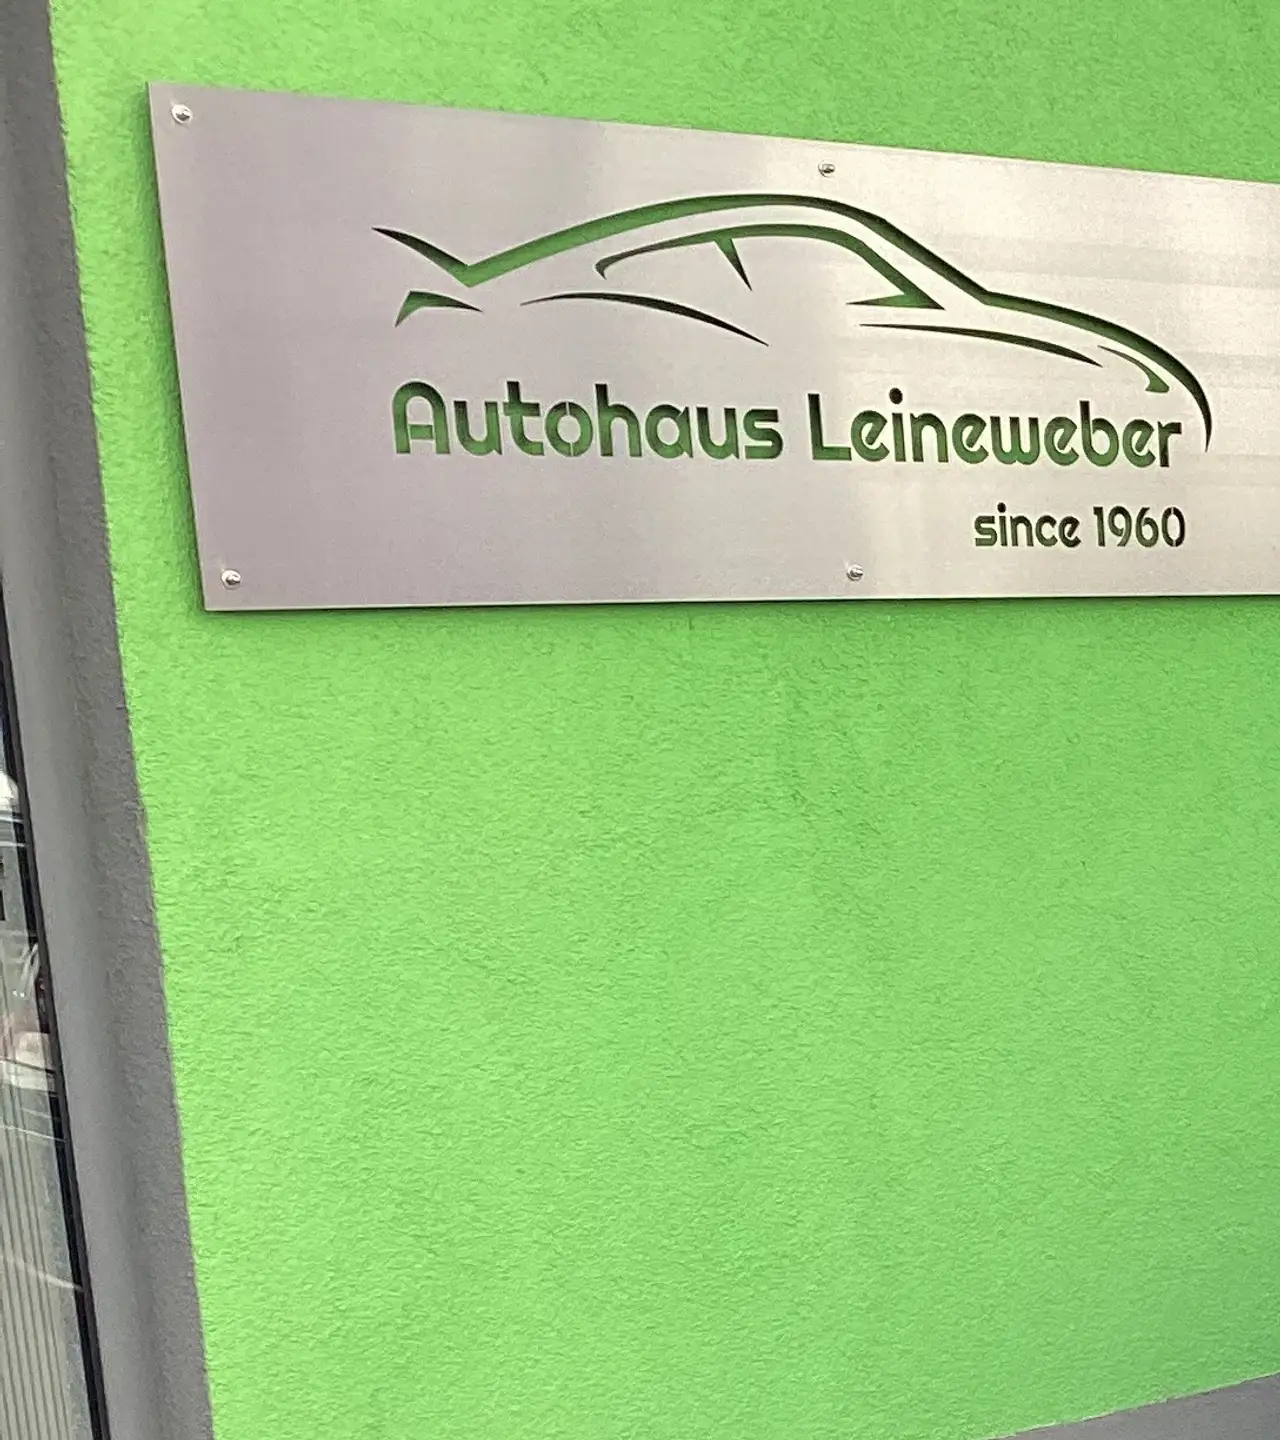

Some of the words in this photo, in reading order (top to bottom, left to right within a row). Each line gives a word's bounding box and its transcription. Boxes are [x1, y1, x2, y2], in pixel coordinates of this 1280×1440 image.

[391, 380, 785, 460] Autohaus
[807, 387, 1183, 468] Leineweber
[973, 501, 1082, 548] since
[1092, 505, 1186, 548] 1960
